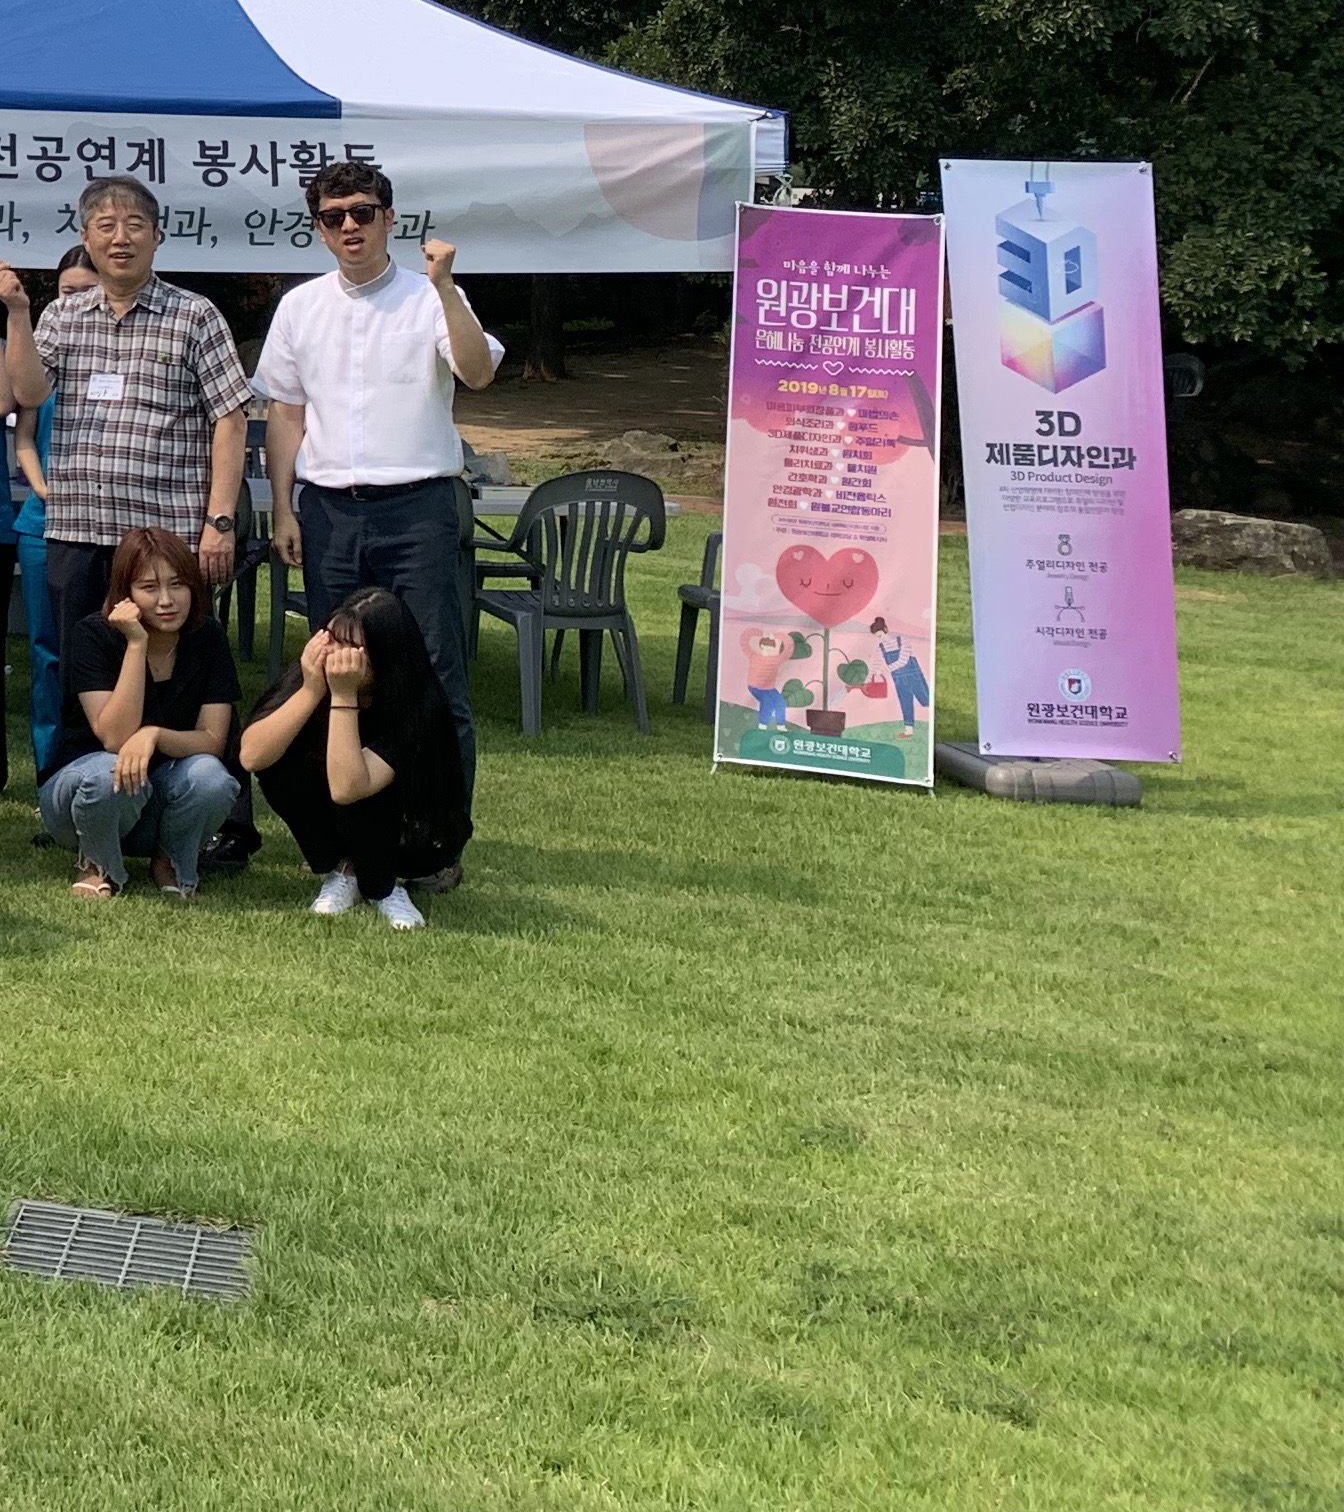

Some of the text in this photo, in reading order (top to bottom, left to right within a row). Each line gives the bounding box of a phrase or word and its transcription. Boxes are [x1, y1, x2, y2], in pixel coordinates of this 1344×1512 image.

[244, 207, 436, 249] 안경과
[824, 261, 850, 277] 함께
[854, 265, 892, 280] 나누는
[756, 278, 916, 336] 원광보건대
[1035, 409, 1083, 438] 3D
[985, 441, 1137, 471] 제품디자인과
[1010, 470, 1113, 486] 3D Product Design
[1025, 559, 1108, 573] 주얼리디자인 전공
[1035, 626, 1085, 639] 시각디자인
[1027, 703, 1128, 720] 원광보건대학교
